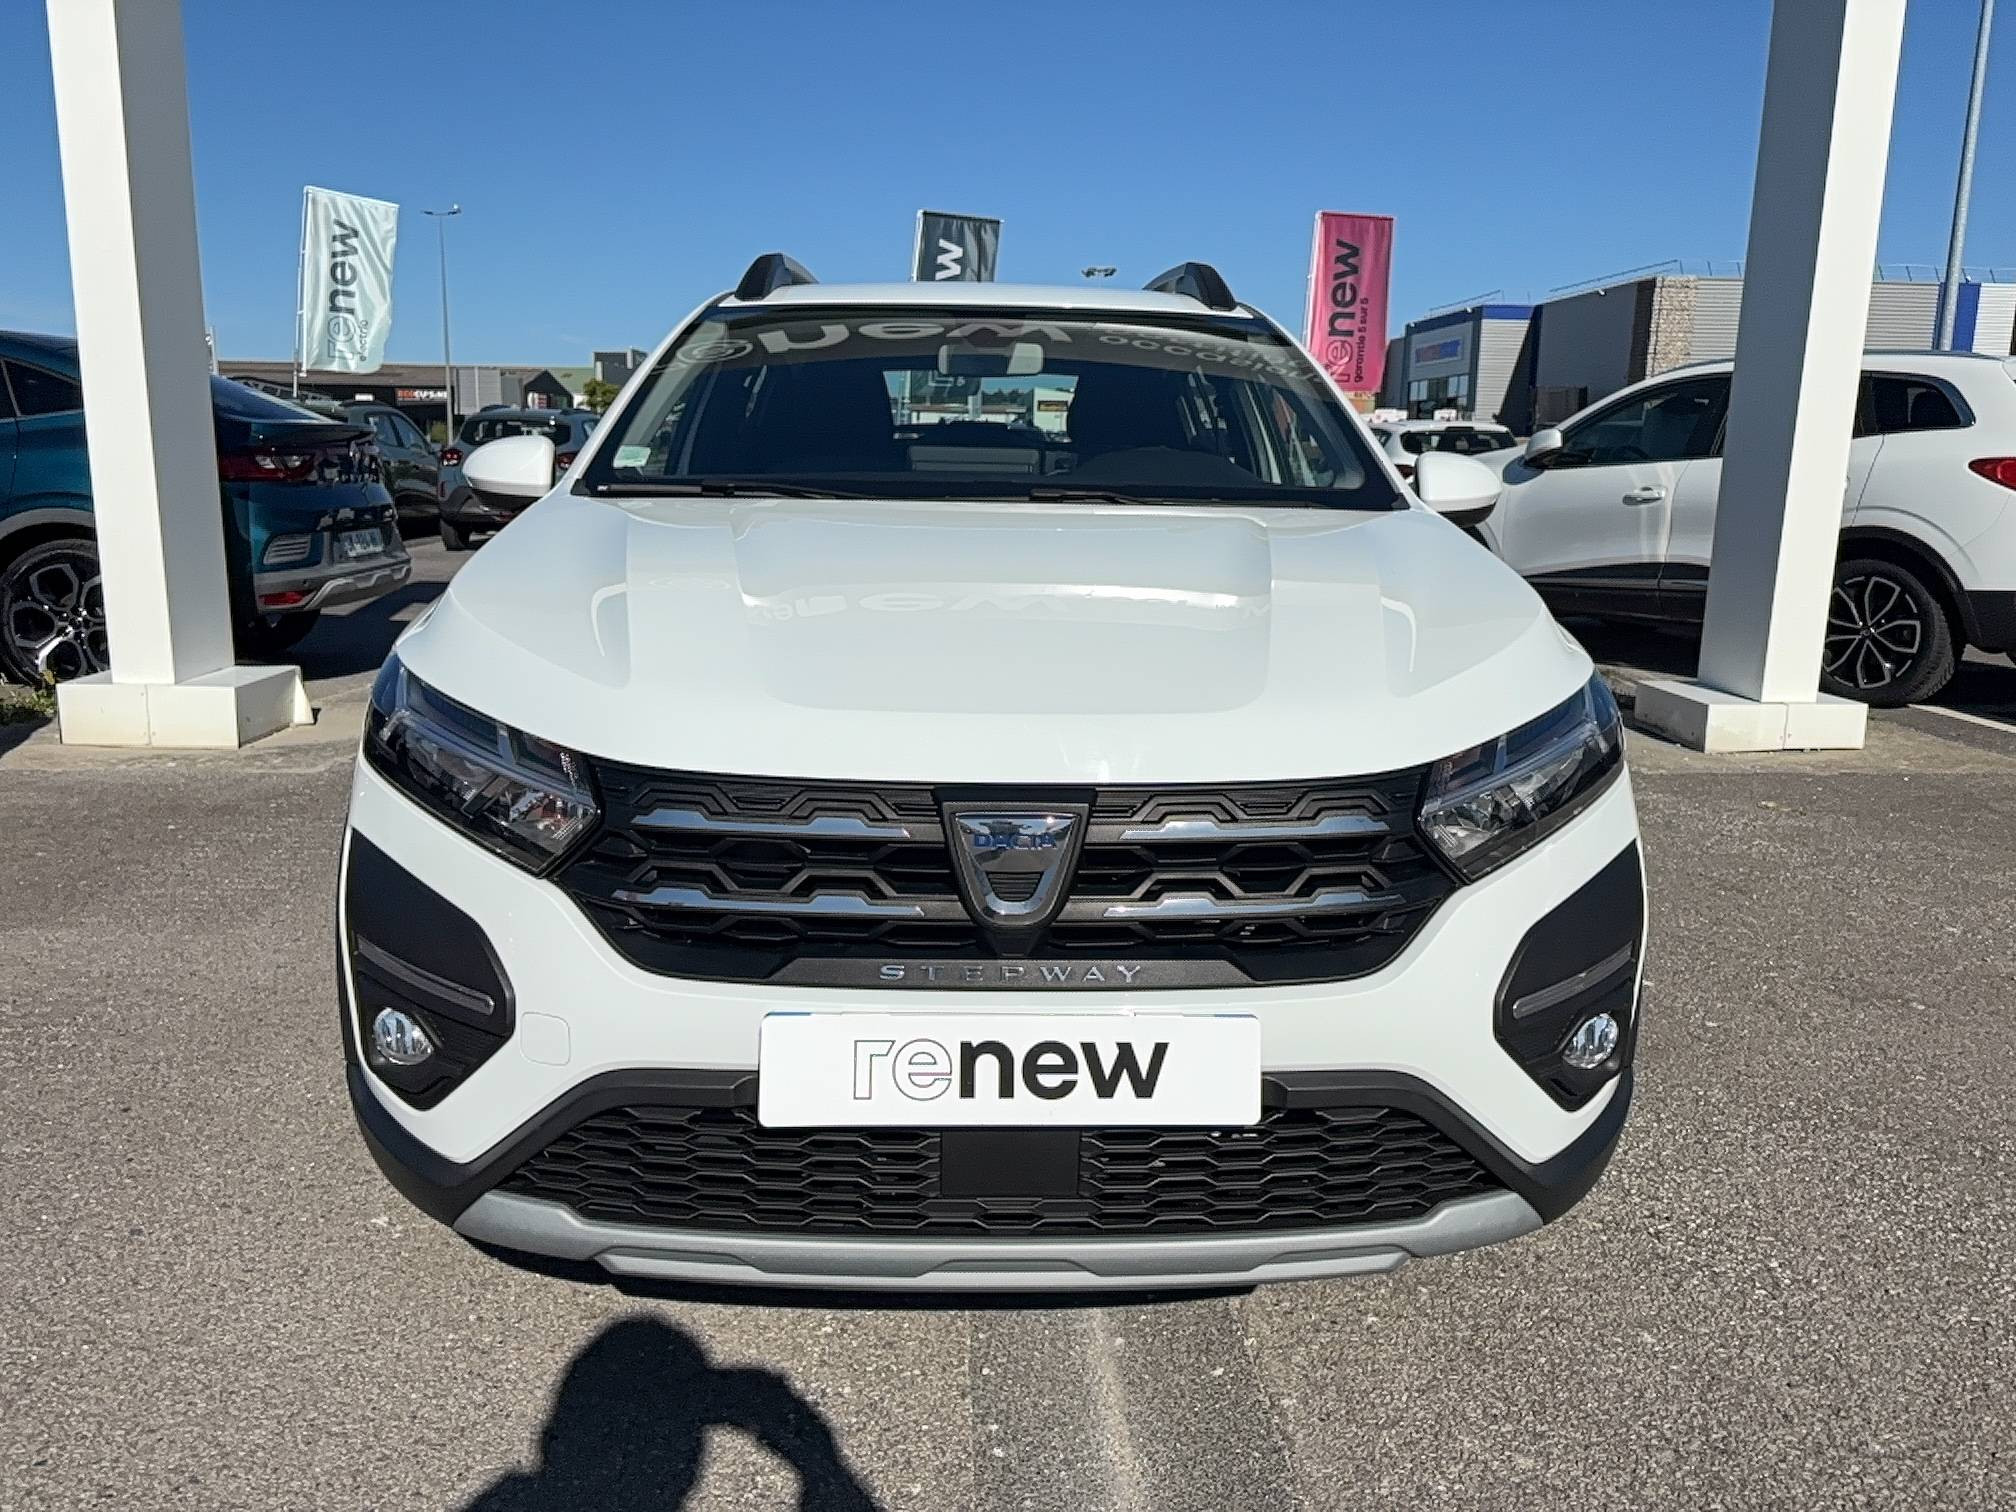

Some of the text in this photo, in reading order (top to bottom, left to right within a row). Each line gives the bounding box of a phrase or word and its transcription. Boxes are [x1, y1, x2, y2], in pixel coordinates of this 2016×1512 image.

[328, 218, 359, 360] renew
[1361, 297, 1369, 305] 5
[1326, 239, 1361, 383] renew
[1360, 306, 1369, 325] sur
[1354, 335, 1366, 383] garantie
[974, 833, 1058, 851] DACIA
[878, 963, 1144, 985] STEPWAY
[852, 1038, 1170, 1101] renew
